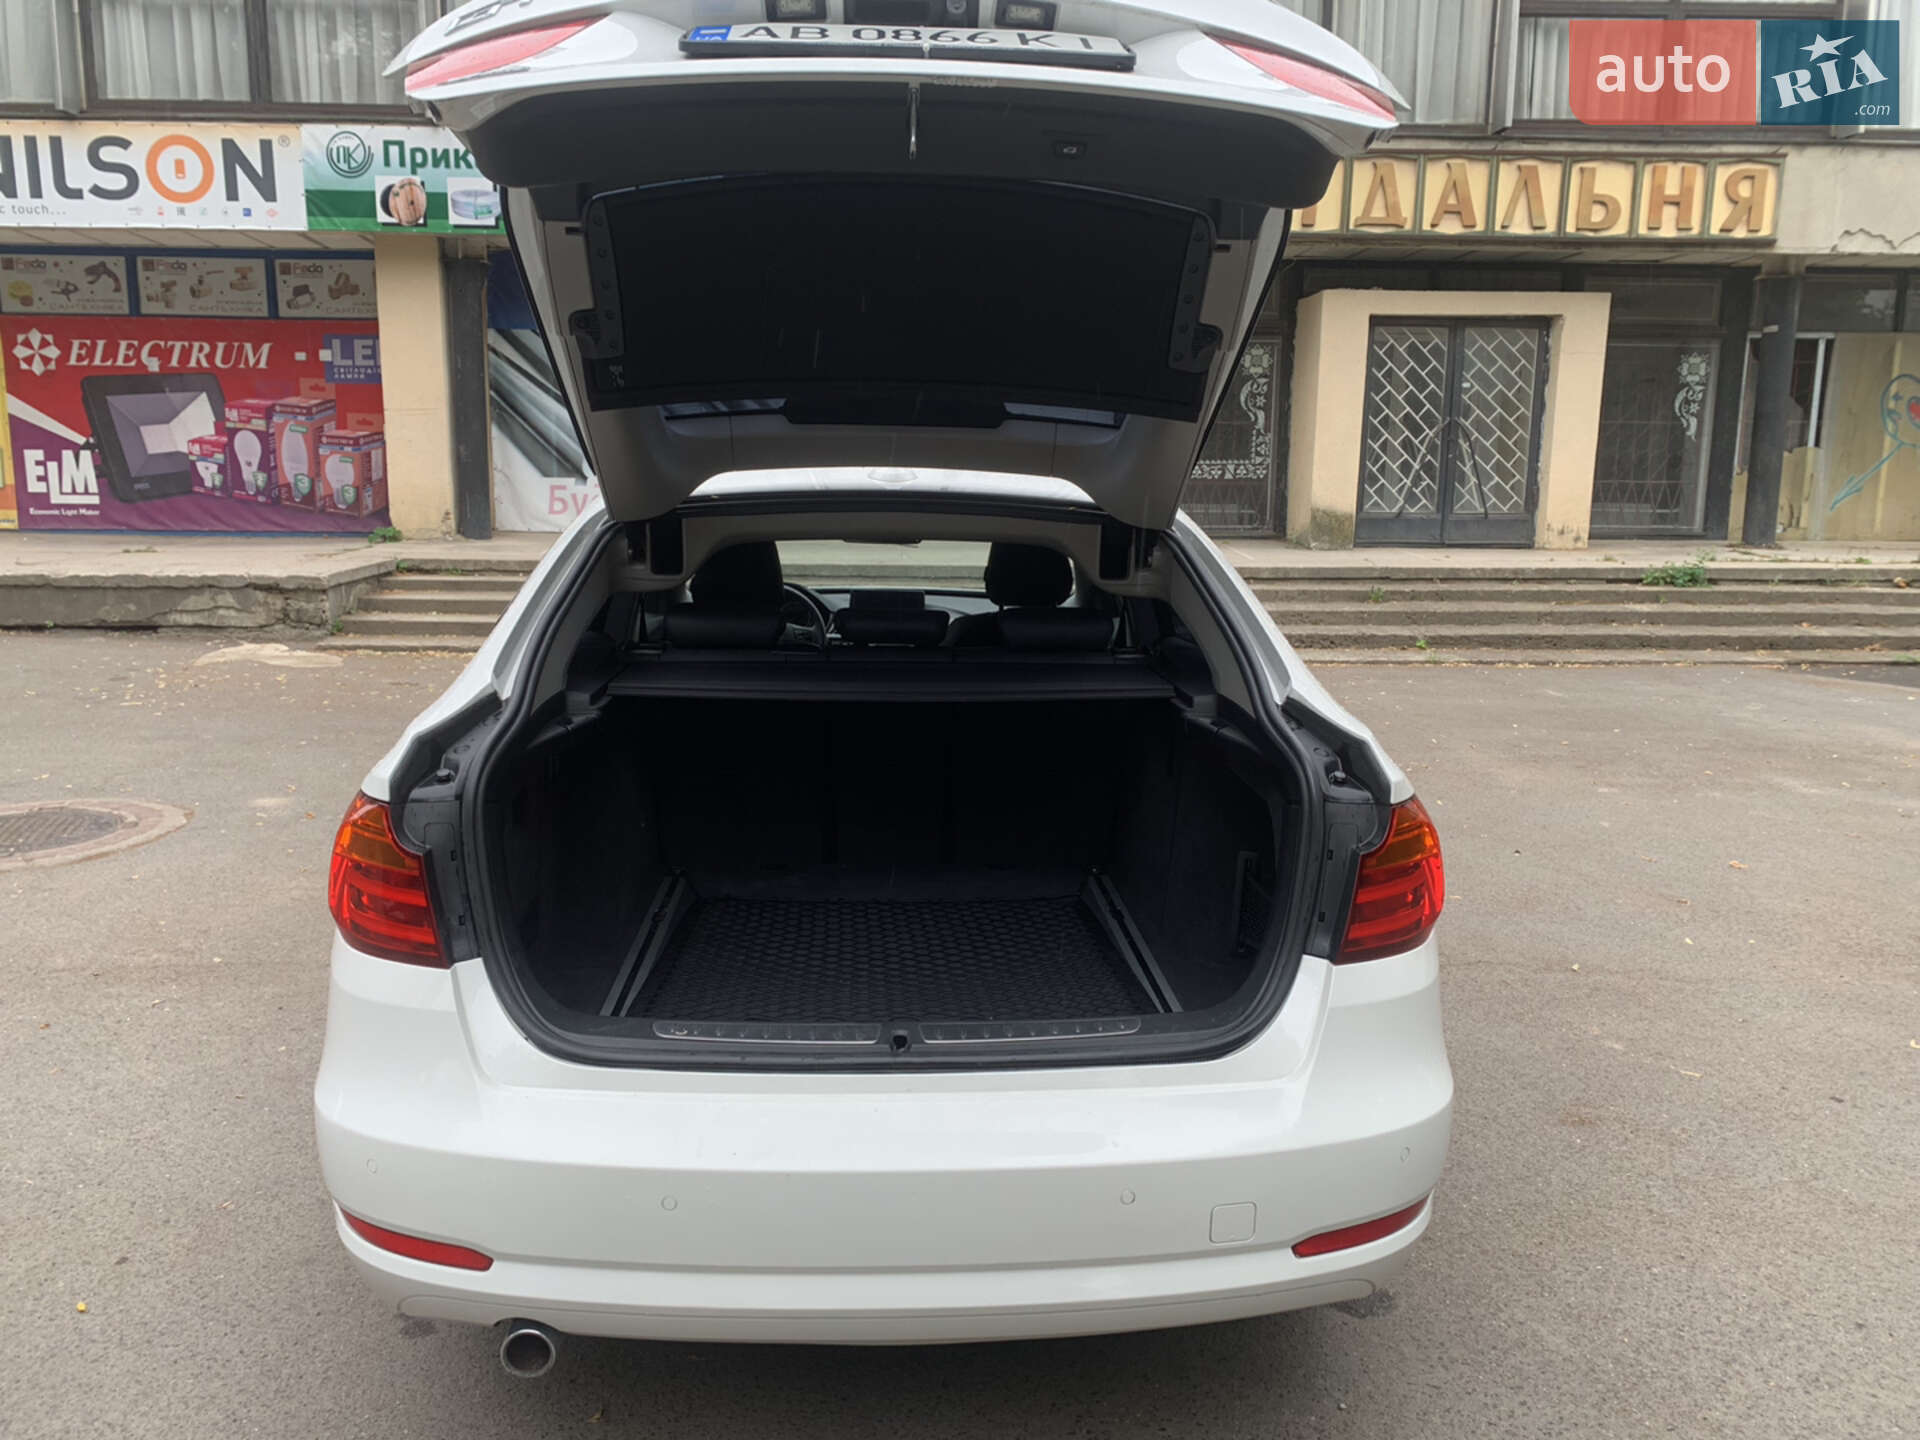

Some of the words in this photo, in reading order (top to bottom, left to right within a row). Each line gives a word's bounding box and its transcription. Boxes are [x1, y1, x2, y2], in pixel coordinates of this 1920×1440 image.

[741, 26, 829, 41] AB
[852, 27, 998, 45] 0866
[66, 339, 272, 371] ELECTRUM
[23, 449, 100, 505] ELM
